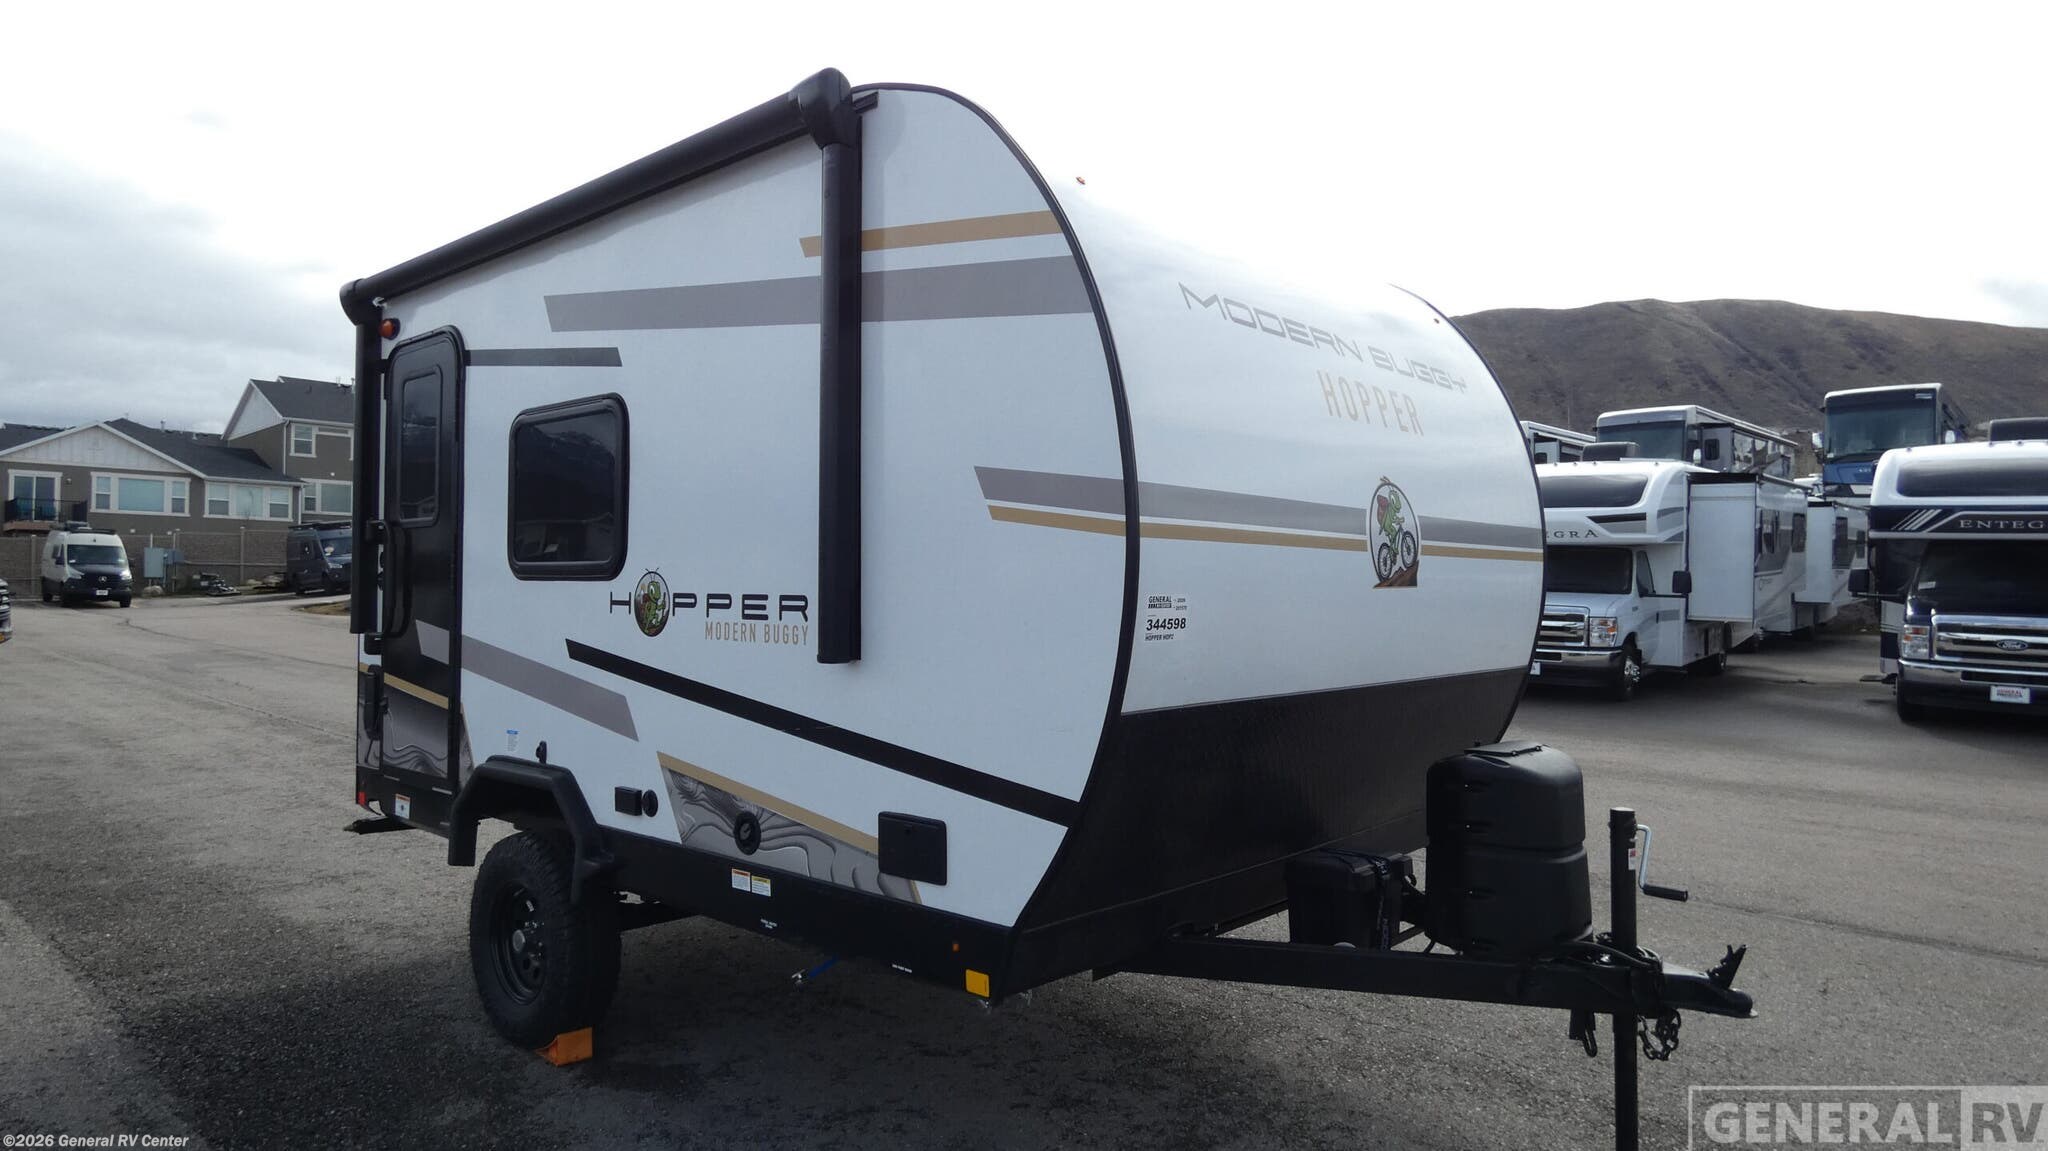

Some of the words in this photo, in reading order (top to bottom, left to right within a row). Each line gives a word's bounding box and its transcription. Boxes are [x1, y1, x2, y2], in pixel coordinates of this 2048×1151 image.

[1178, 281, 1363, 362] MODERN
[1368, 345, 1467, 394] BUGGY
[1317, 369, 1424, 437] HOPPER
[1959, 519, 2045, 529] ENTEG
[1148, 595, 1172, 603] GENERAL
[705, 621, 757, 643] MODERN
[764, 623, 809, 646] BUGGY
[1146, 617, 1186, 631] 344598
